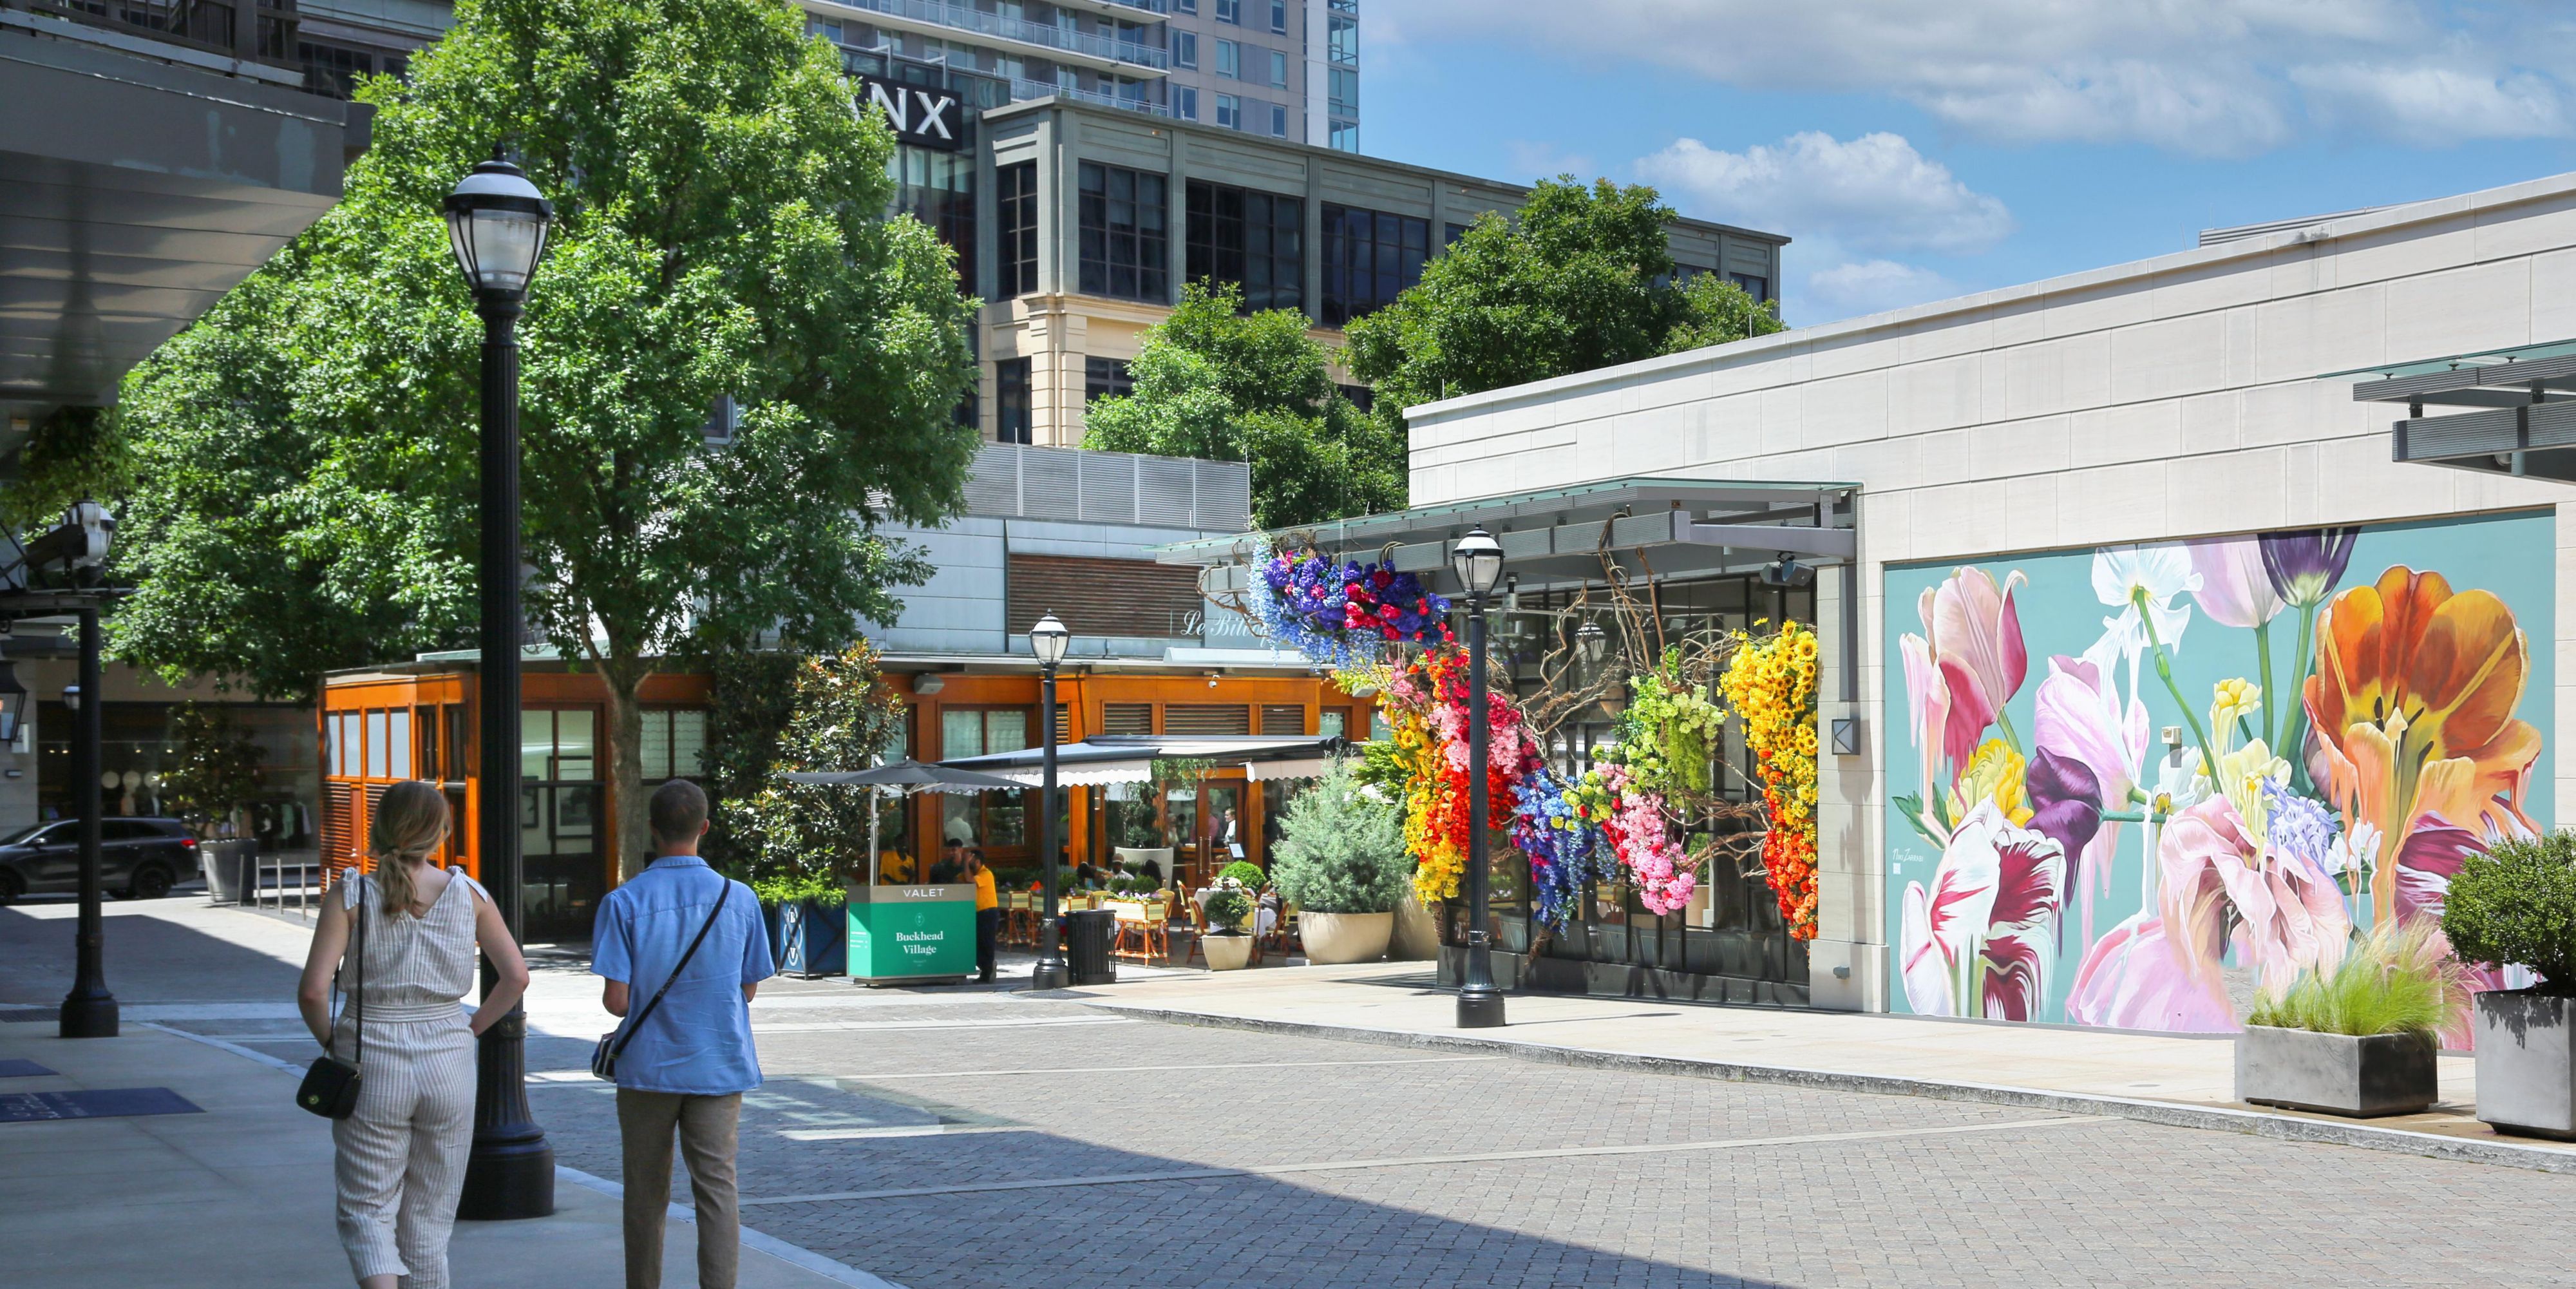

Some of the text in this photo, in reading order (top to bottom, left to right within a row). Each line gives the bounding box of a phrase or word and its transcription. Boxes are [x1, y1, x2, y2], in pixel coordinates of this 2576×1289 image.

[1180, 610, 1206, 635] Le
[903, 888, 945, 897] VALET
[896, 931, 943, 942] Buckhead
[903, 944, 937, 956] Village
